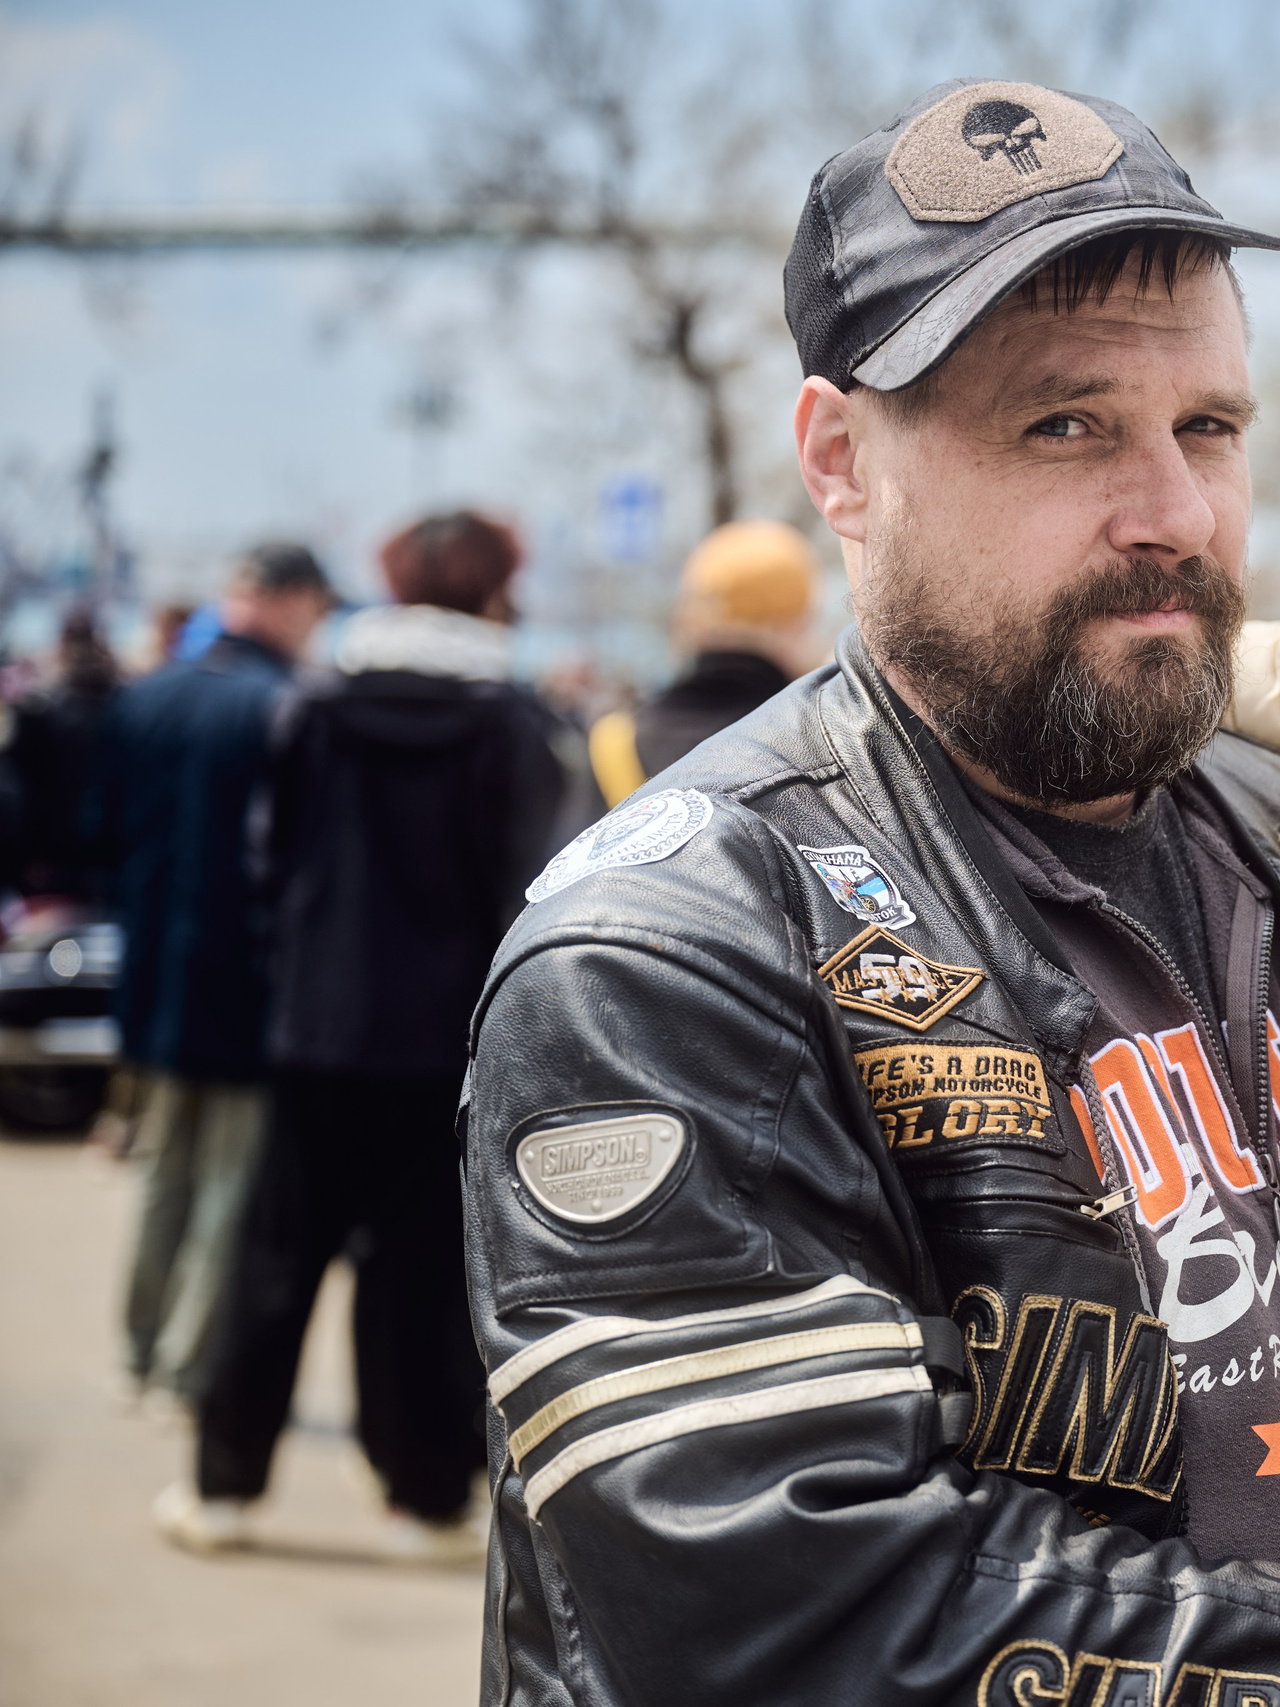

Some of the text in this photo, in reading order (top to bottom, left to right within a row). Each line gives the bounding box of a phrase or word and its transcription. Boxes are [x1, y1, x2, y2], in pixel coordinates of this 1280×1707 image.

[831, 966, 958, 993] MASTERPIECE
[947, 1056, 962, 1075] A
[976, 1056, 1037, 1081] DRAG
[868, 1077, 1042, 1105] PSON MOTORCYCLE
[544, 1135, 636, 1176] SIMPSON
[951, 1285, 1184, 1501] SIM
